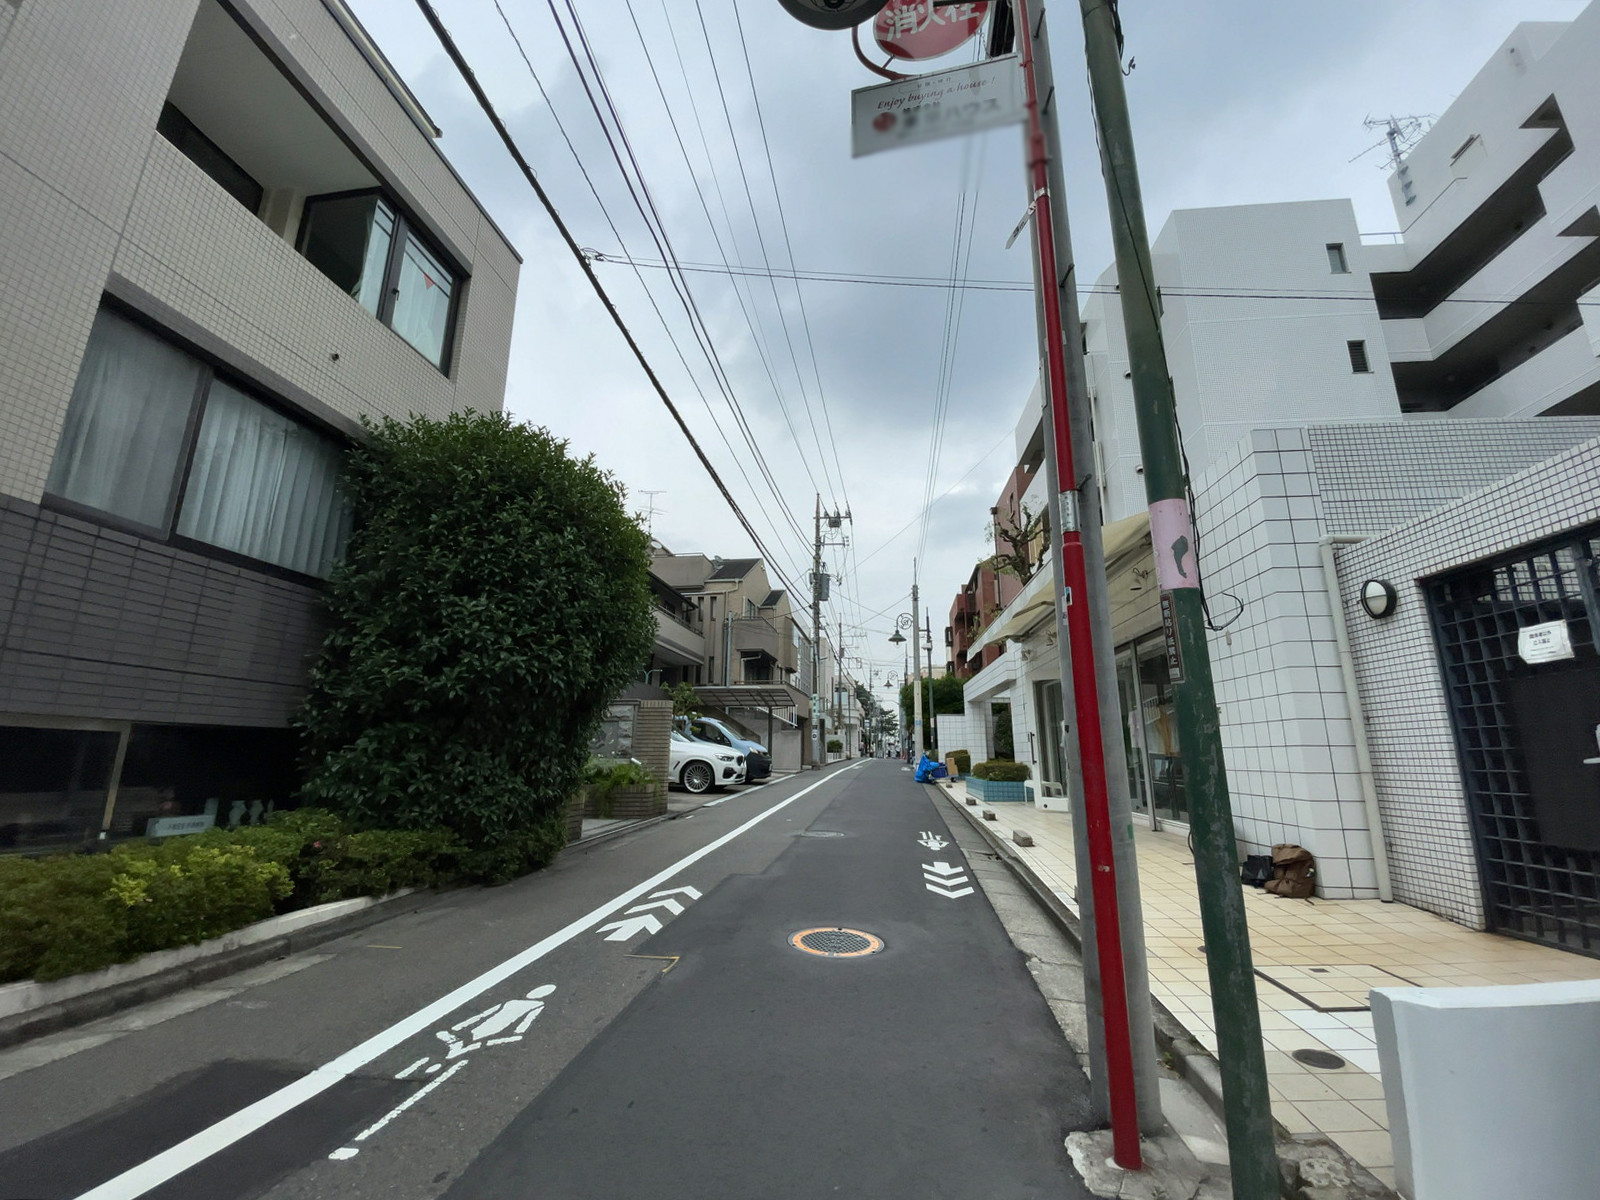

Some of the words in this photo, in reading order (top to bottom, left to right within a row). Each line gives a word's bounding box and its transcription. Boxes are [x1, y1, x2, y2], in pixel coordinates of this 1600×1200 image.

[877, 96, 905, 111] Enjoy
[908, 87, 944, 103] buying
[957, 80, 987, 92] house
